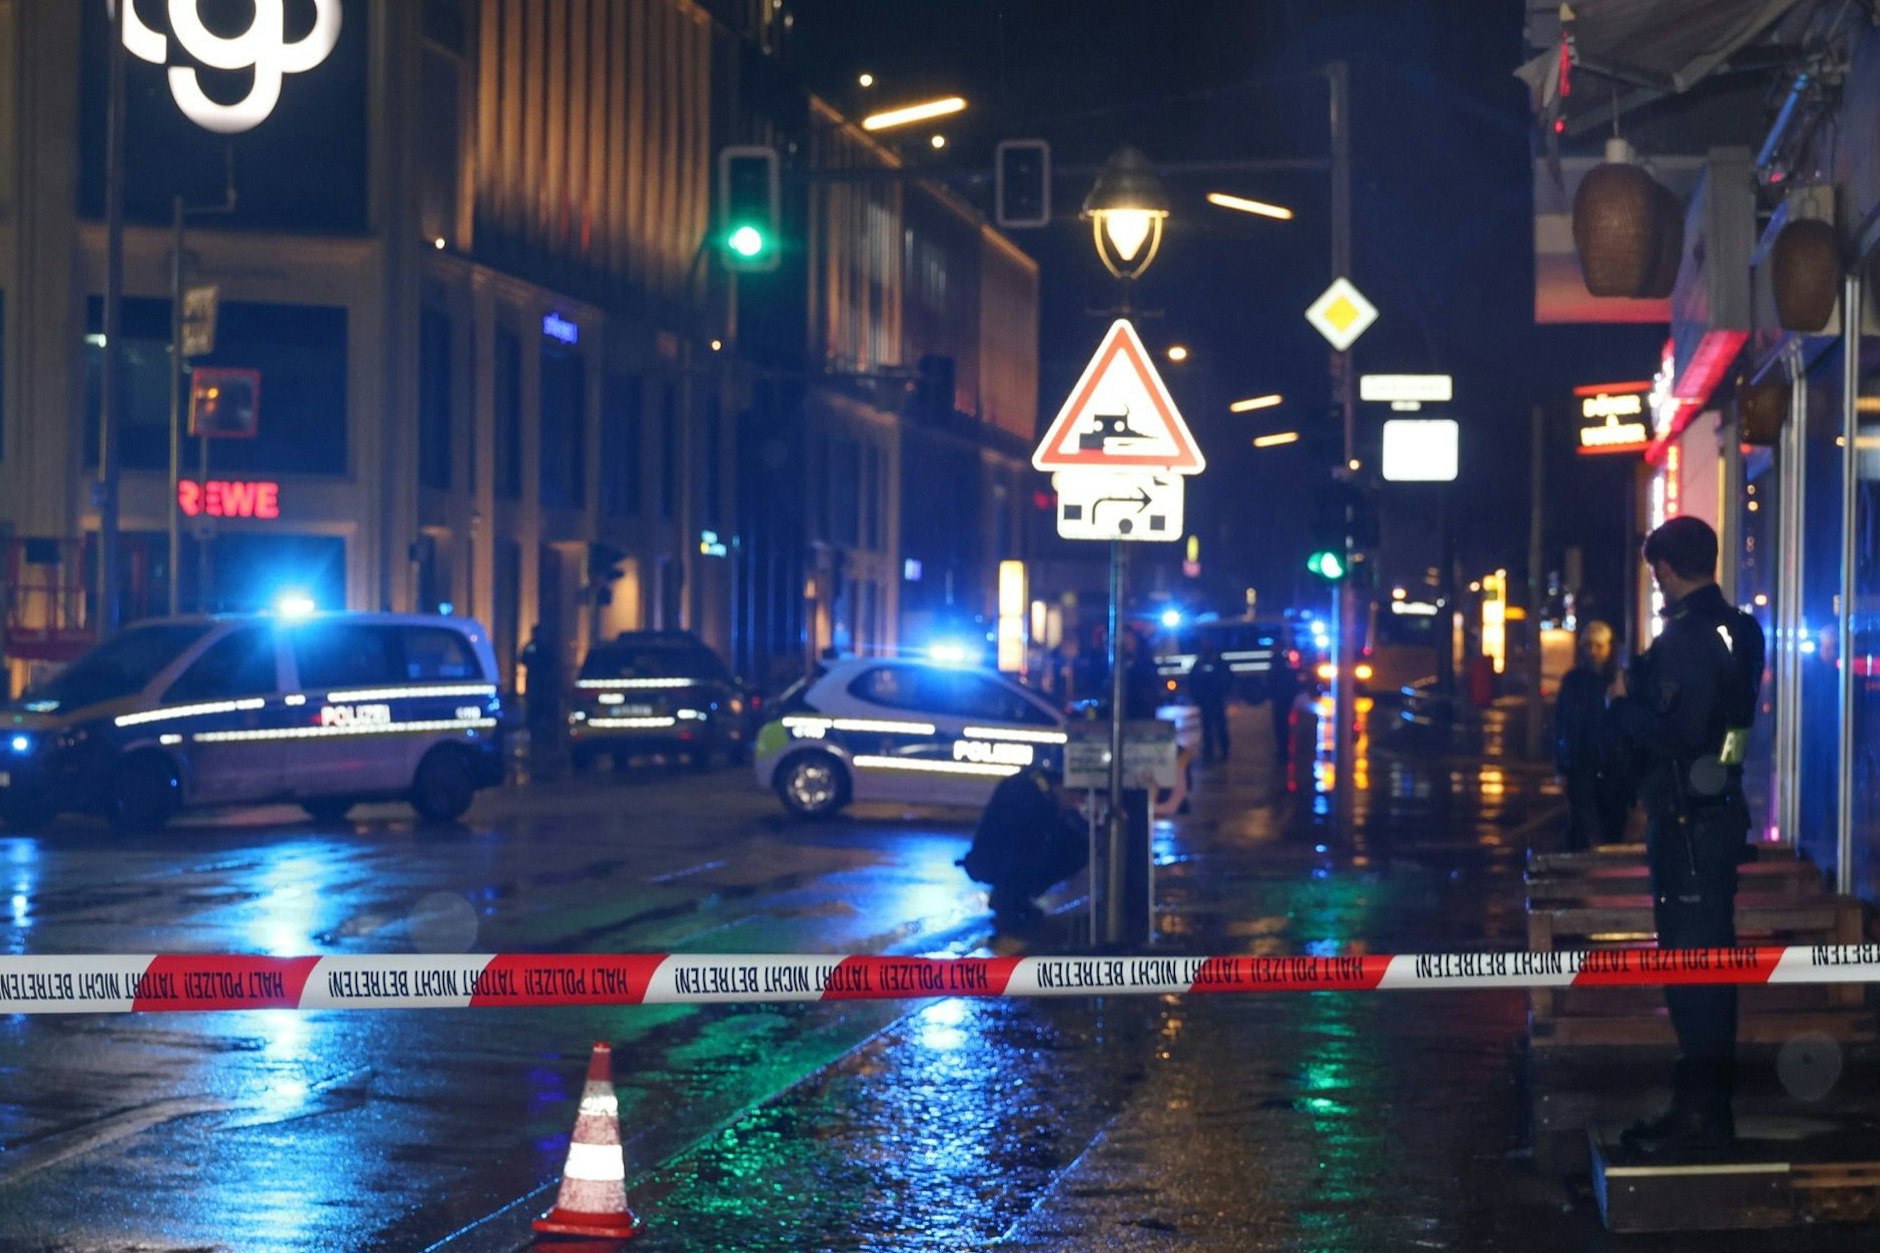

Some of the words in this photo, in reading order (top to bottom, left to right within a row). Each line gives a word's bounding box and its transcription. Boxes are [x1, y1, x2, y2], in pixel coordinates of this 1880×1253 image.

[178, 479, 280, 519] REWE
[1182, 958, 1243, 985] TATORT
[1251, 957, 1318, 984] POLIZEI!
[1322, 957, 1364, 982] HALT
[1415, 953, 1507, 979] BETRETEN!
[1512, 952, 1562, 975] NICHT
[1568, 951, 1631, 974] TATORT
[1715, 947, 1758, 969] HALT
[78, 973, 122, 999] NICHT
[125, 972, 178, 999] TATORT
[184, 971, 244, 998] POLIZEI!
[248, 971, 285, 998] HALT
[328, 970, 410, 998] BETRETEN!
[413, 969, 458, 997] NICHT
[462, 968, 518, 997] TATORT
[524, 968, 586, 995] POLIZEI!
[591, 968, 628, 994] HALT
[674, 967, 759, 993] BETRETEN!
[764, 965, 810, 992] NICHT
[815, 964, 873, 992] TATORT
[879, 963, 944, 990] POLIZEI!
[949, 962, 988, 989] HALT
[1037, 961, 1125, 988] BETRETEN!
[1130, 959, 1177, 986] NICHT
